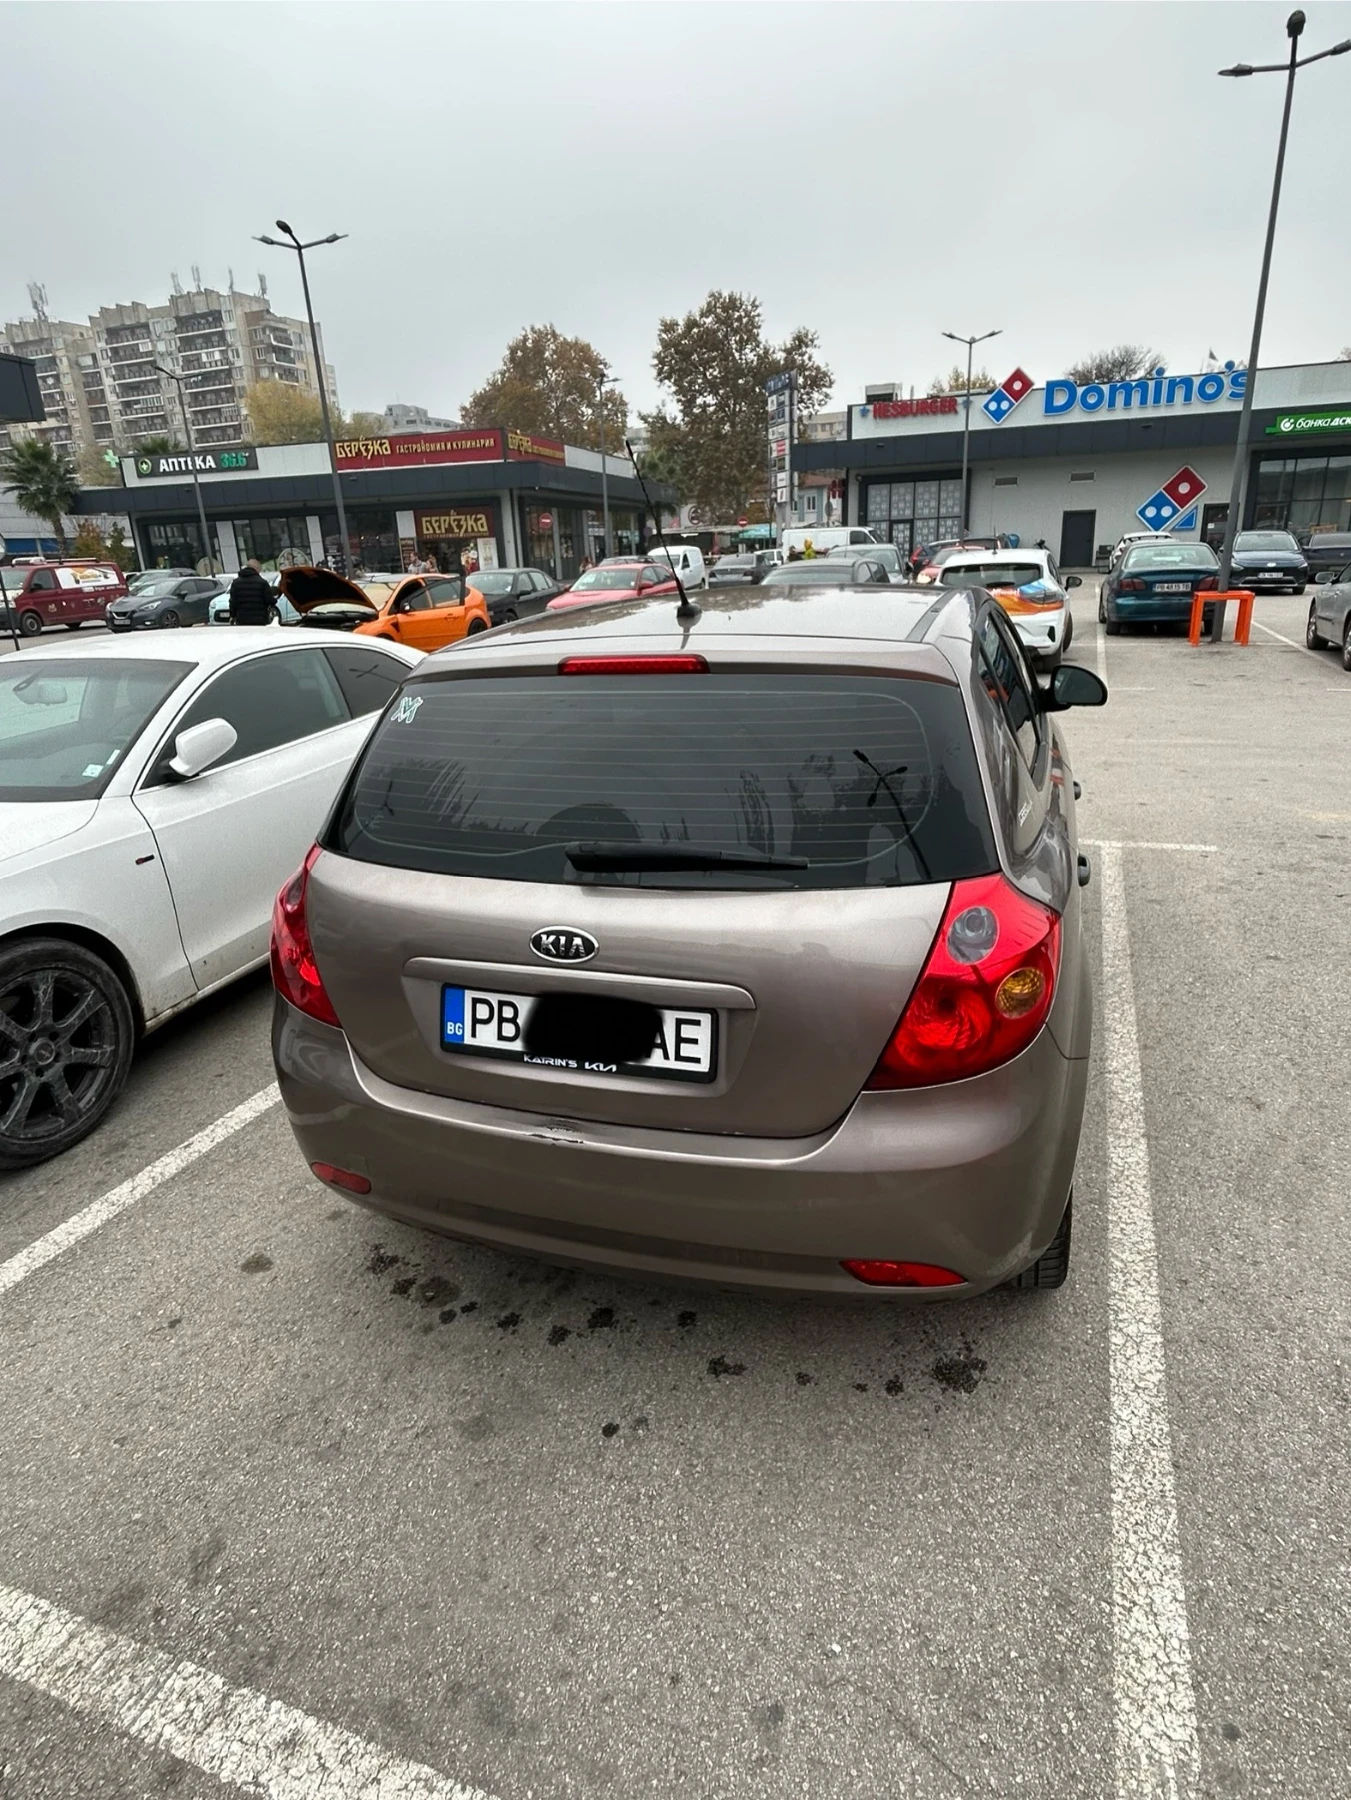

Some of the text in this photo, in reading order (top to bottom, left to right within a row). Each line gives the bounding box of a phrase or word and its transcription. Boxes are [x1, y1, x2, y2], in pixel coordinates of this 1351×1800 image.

[1044, 360, 1249, 416] Domino's
[872, 397, 958, 419] HESBURGER
[1295, 418, 1331, 429] банка
[396, 440, 445, 454] ГАСТРОНОМИЯ
[446, 441, 452, 450] И
[453, 438, 495, 449] КУЛИНАРИЯ
[540, 934, 586, 957] KIA
[447, 1021, 463, 1036] BG
[470, 996, 521, 1042] PB
[523, 1053, 578, 1068] KATRIN'S
